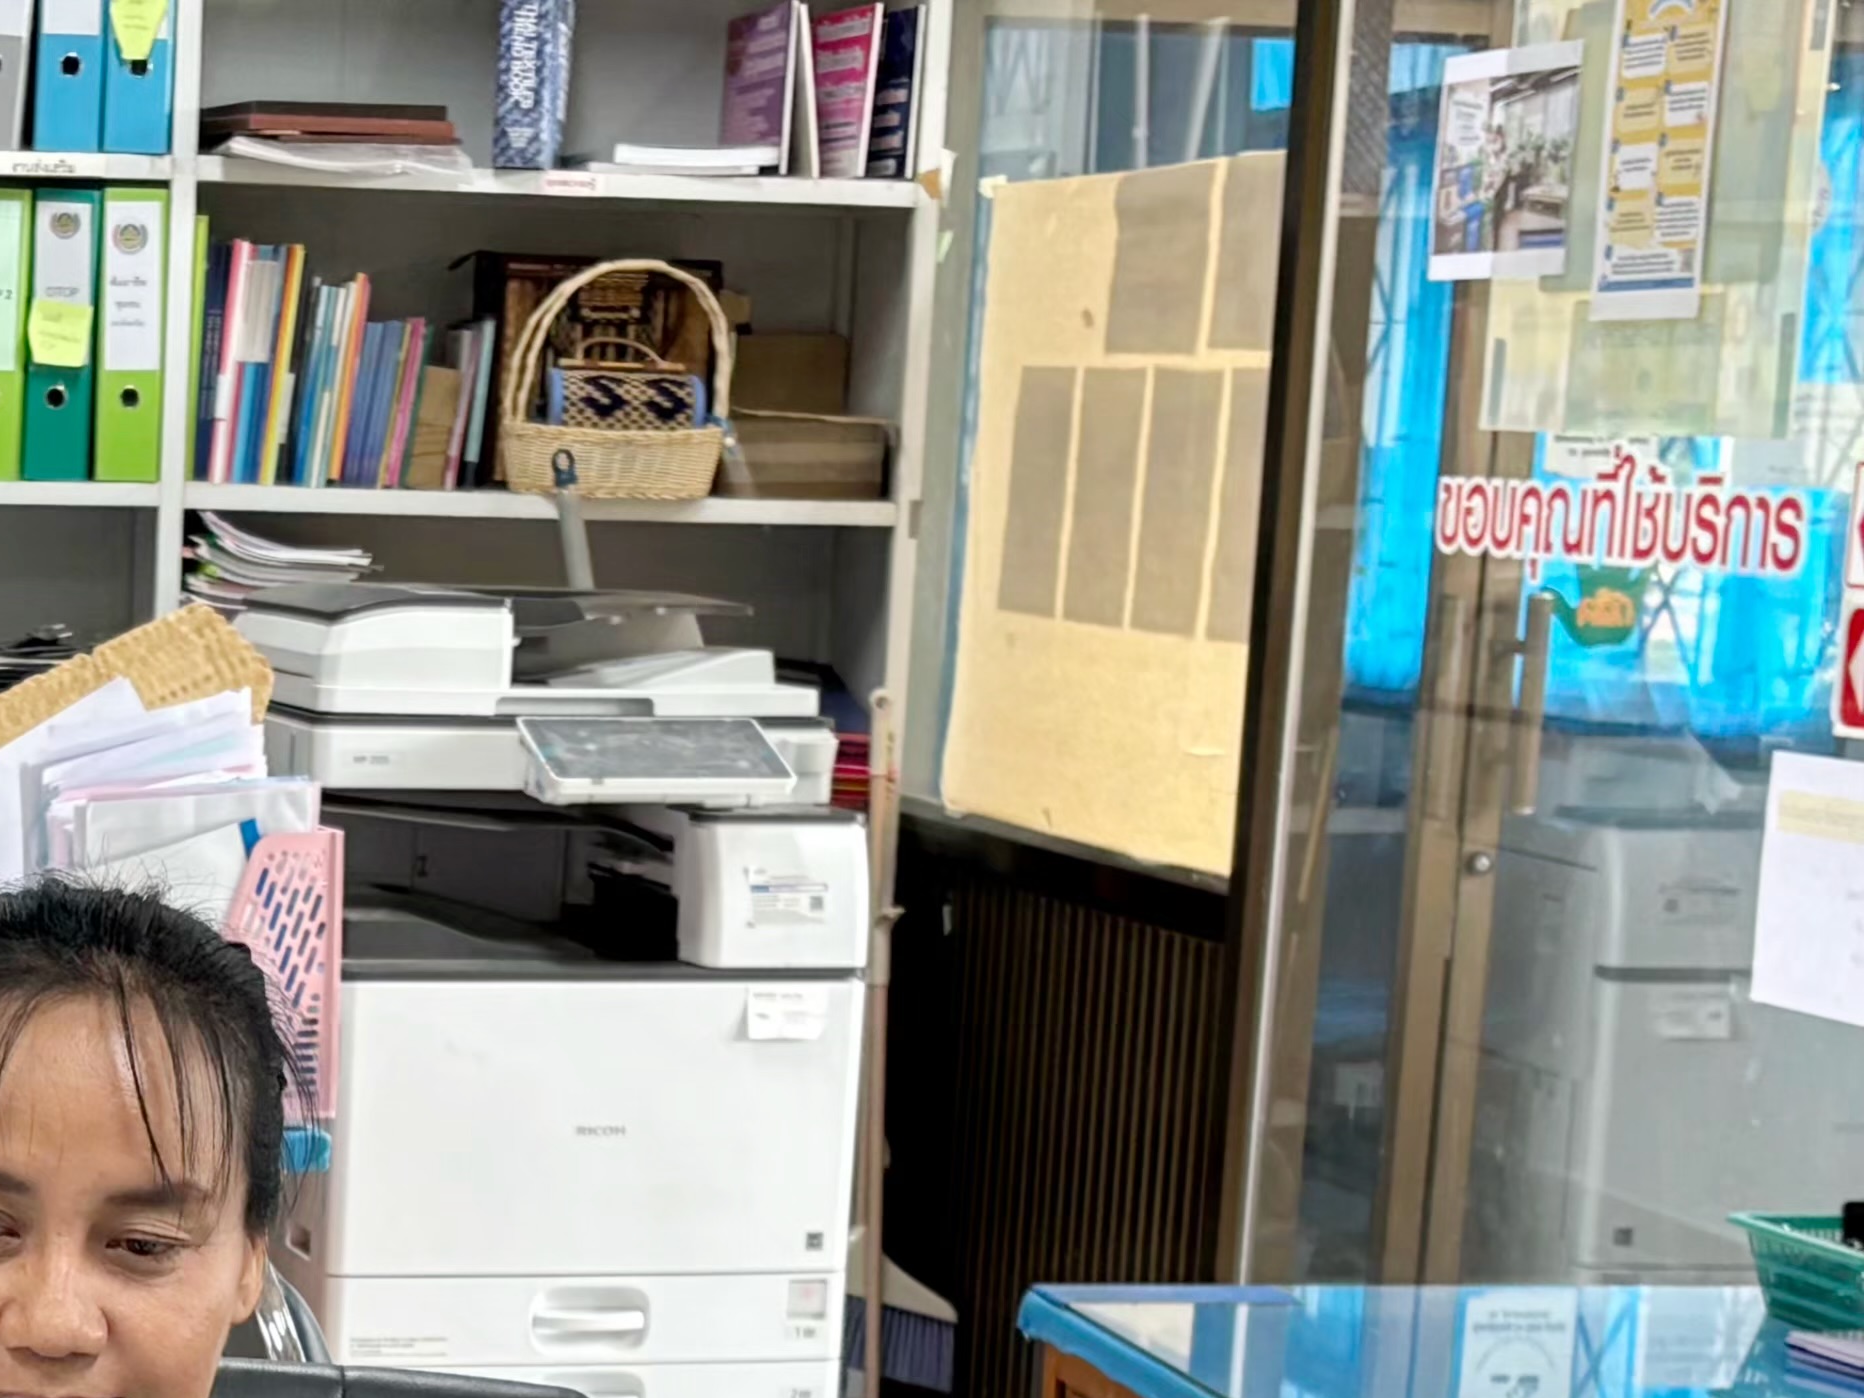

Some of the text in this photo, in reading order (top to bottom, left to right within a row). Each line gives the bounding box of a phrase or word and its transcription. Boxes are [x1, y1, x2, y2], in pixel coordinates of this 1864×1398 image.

[1439, 445, 1804, 581] ขอบคุณที่ใช้บริการ
[575, 1124, 626, 1137] RICOH
